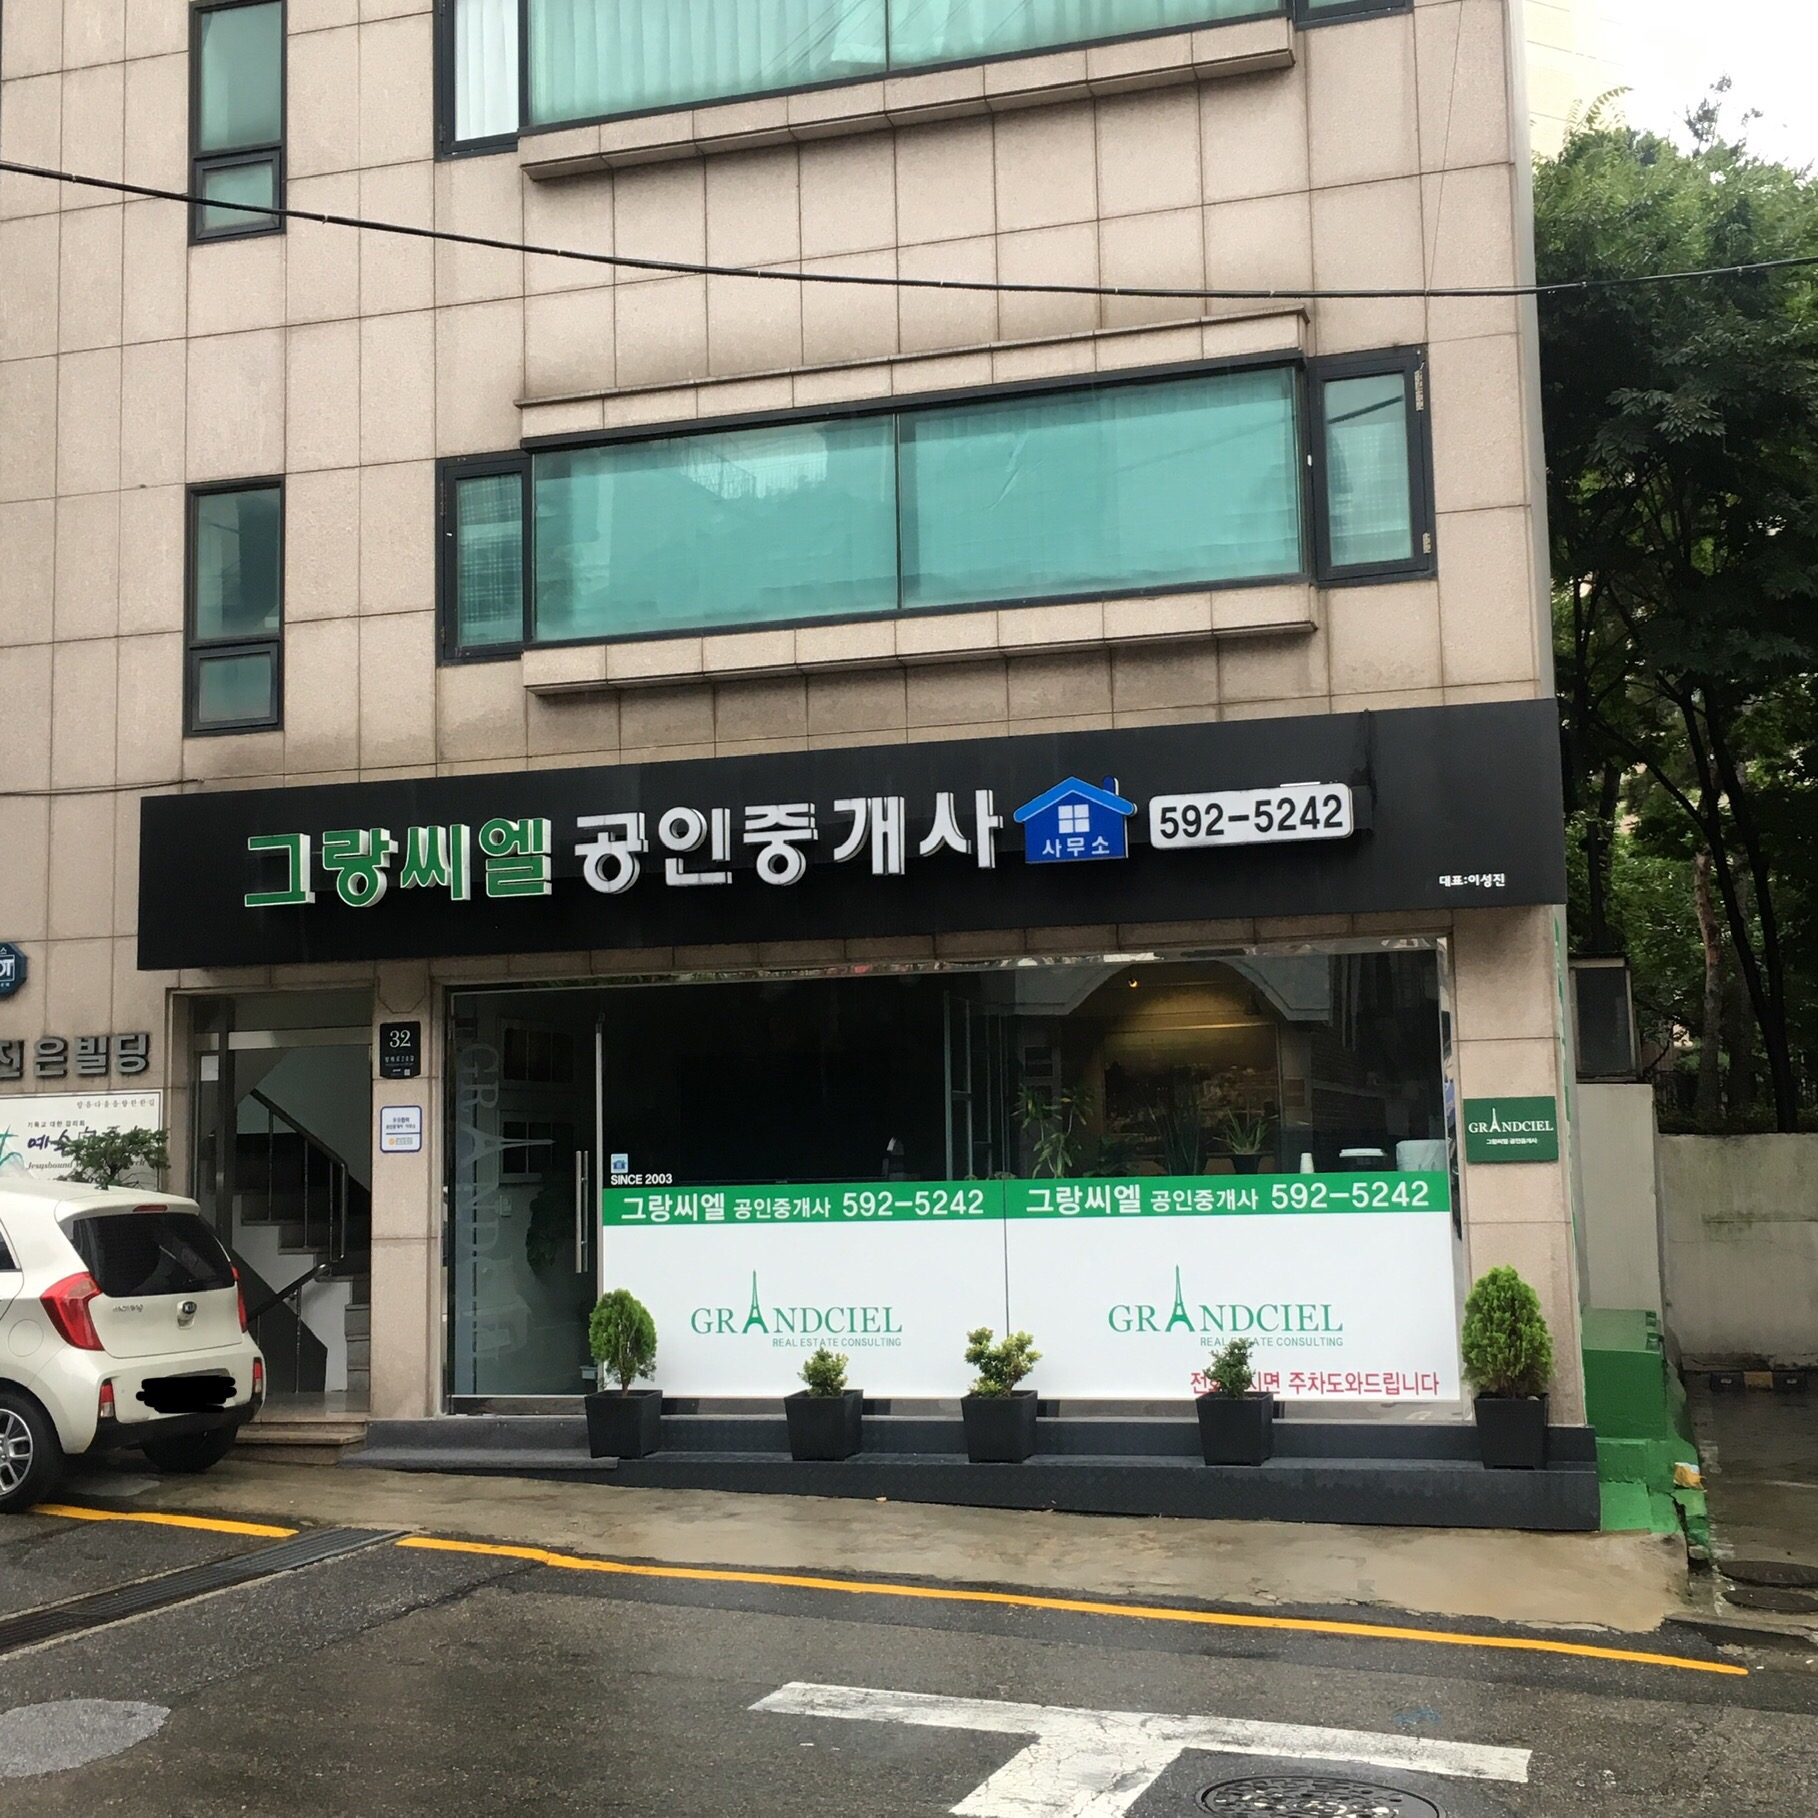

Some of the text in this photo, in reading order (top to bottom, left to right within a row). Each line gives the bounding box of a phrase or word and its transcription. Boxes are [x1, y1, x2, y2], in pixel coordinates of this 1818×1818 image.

[245, 789, 1344, 907] 그랑씨엘 공인중개사 사무소 592-5242
[1439, 873, 1505, 888] 대표:이성진
[389, 1030, 411, 1048] 32
[1468, 1108, 1554, 1133] GRANDCIEL
[610, 1173, 673, 1185] SINCE 2003
[621, 1190, 984, 1222] 그랑씨엘 공인중개사 592-5242
[1026, 1180, 1429, 1214] 그랑씨엘 공인중개사 592-5242
[691, 1269, 903, 1334] GRANDCIEL
[1108, 1264, 1343, 1332] GRANDCIEL
[772, 1337, 902, 1347] REAL ESTATE CONSULTING
[1276, 1337, 1344, 1347] CONSULTING
[1288, 1371, 1440, 1395] 주차도와드립니다
